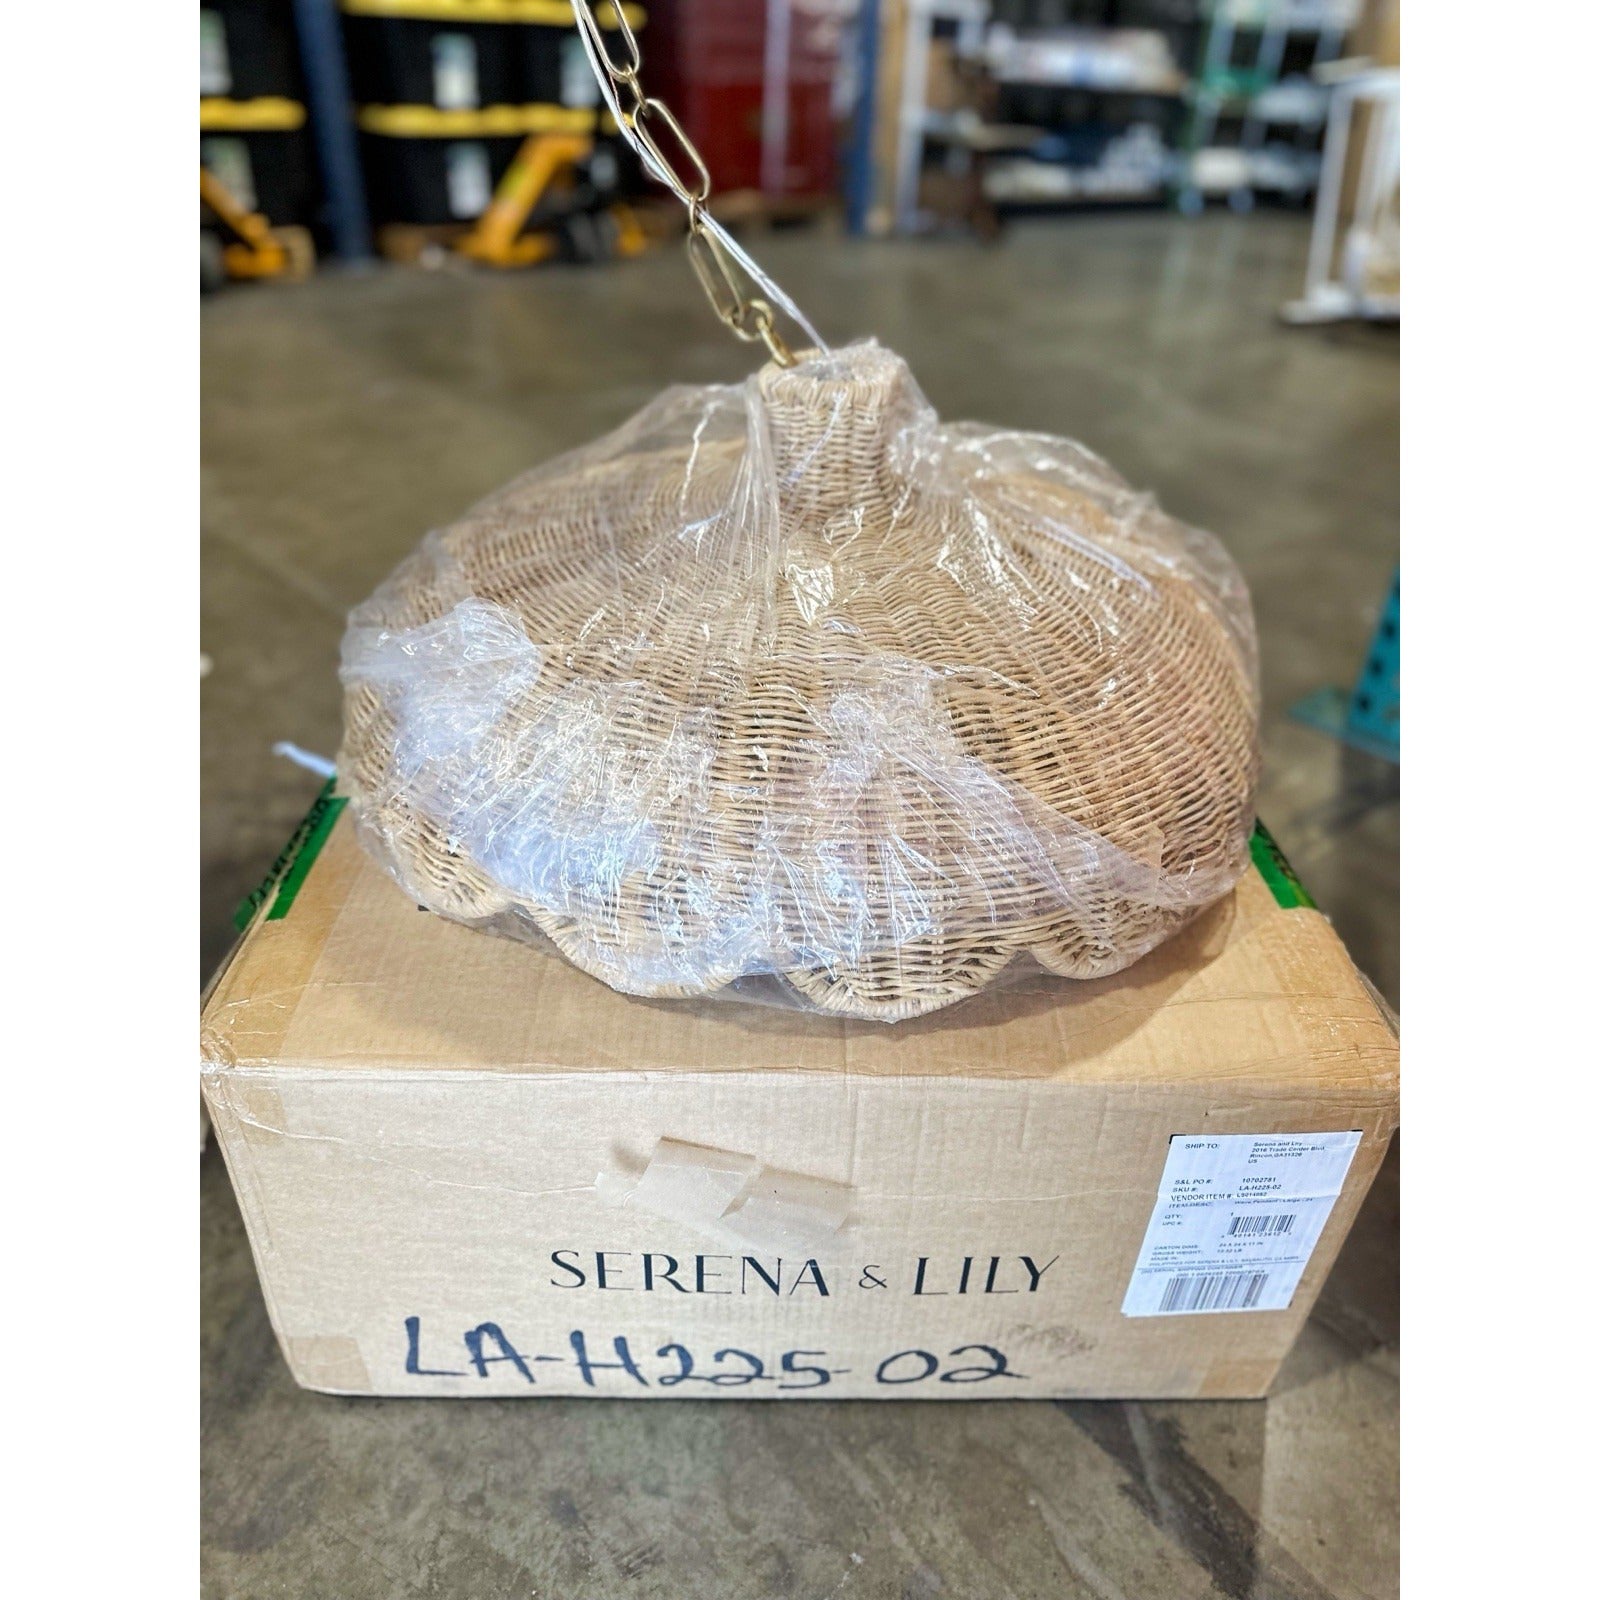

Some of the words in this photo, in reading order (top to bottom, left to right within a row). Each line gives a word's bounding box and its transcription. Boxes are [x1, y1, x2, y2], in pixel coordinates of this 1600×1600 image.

[1170, 1194, 1205, 1202] VENDOR
[550, 1250, 830, 1297] SERENA
[859, 1264, 888, 1290] &
[913, 1255, 1060, 1296] LILY
